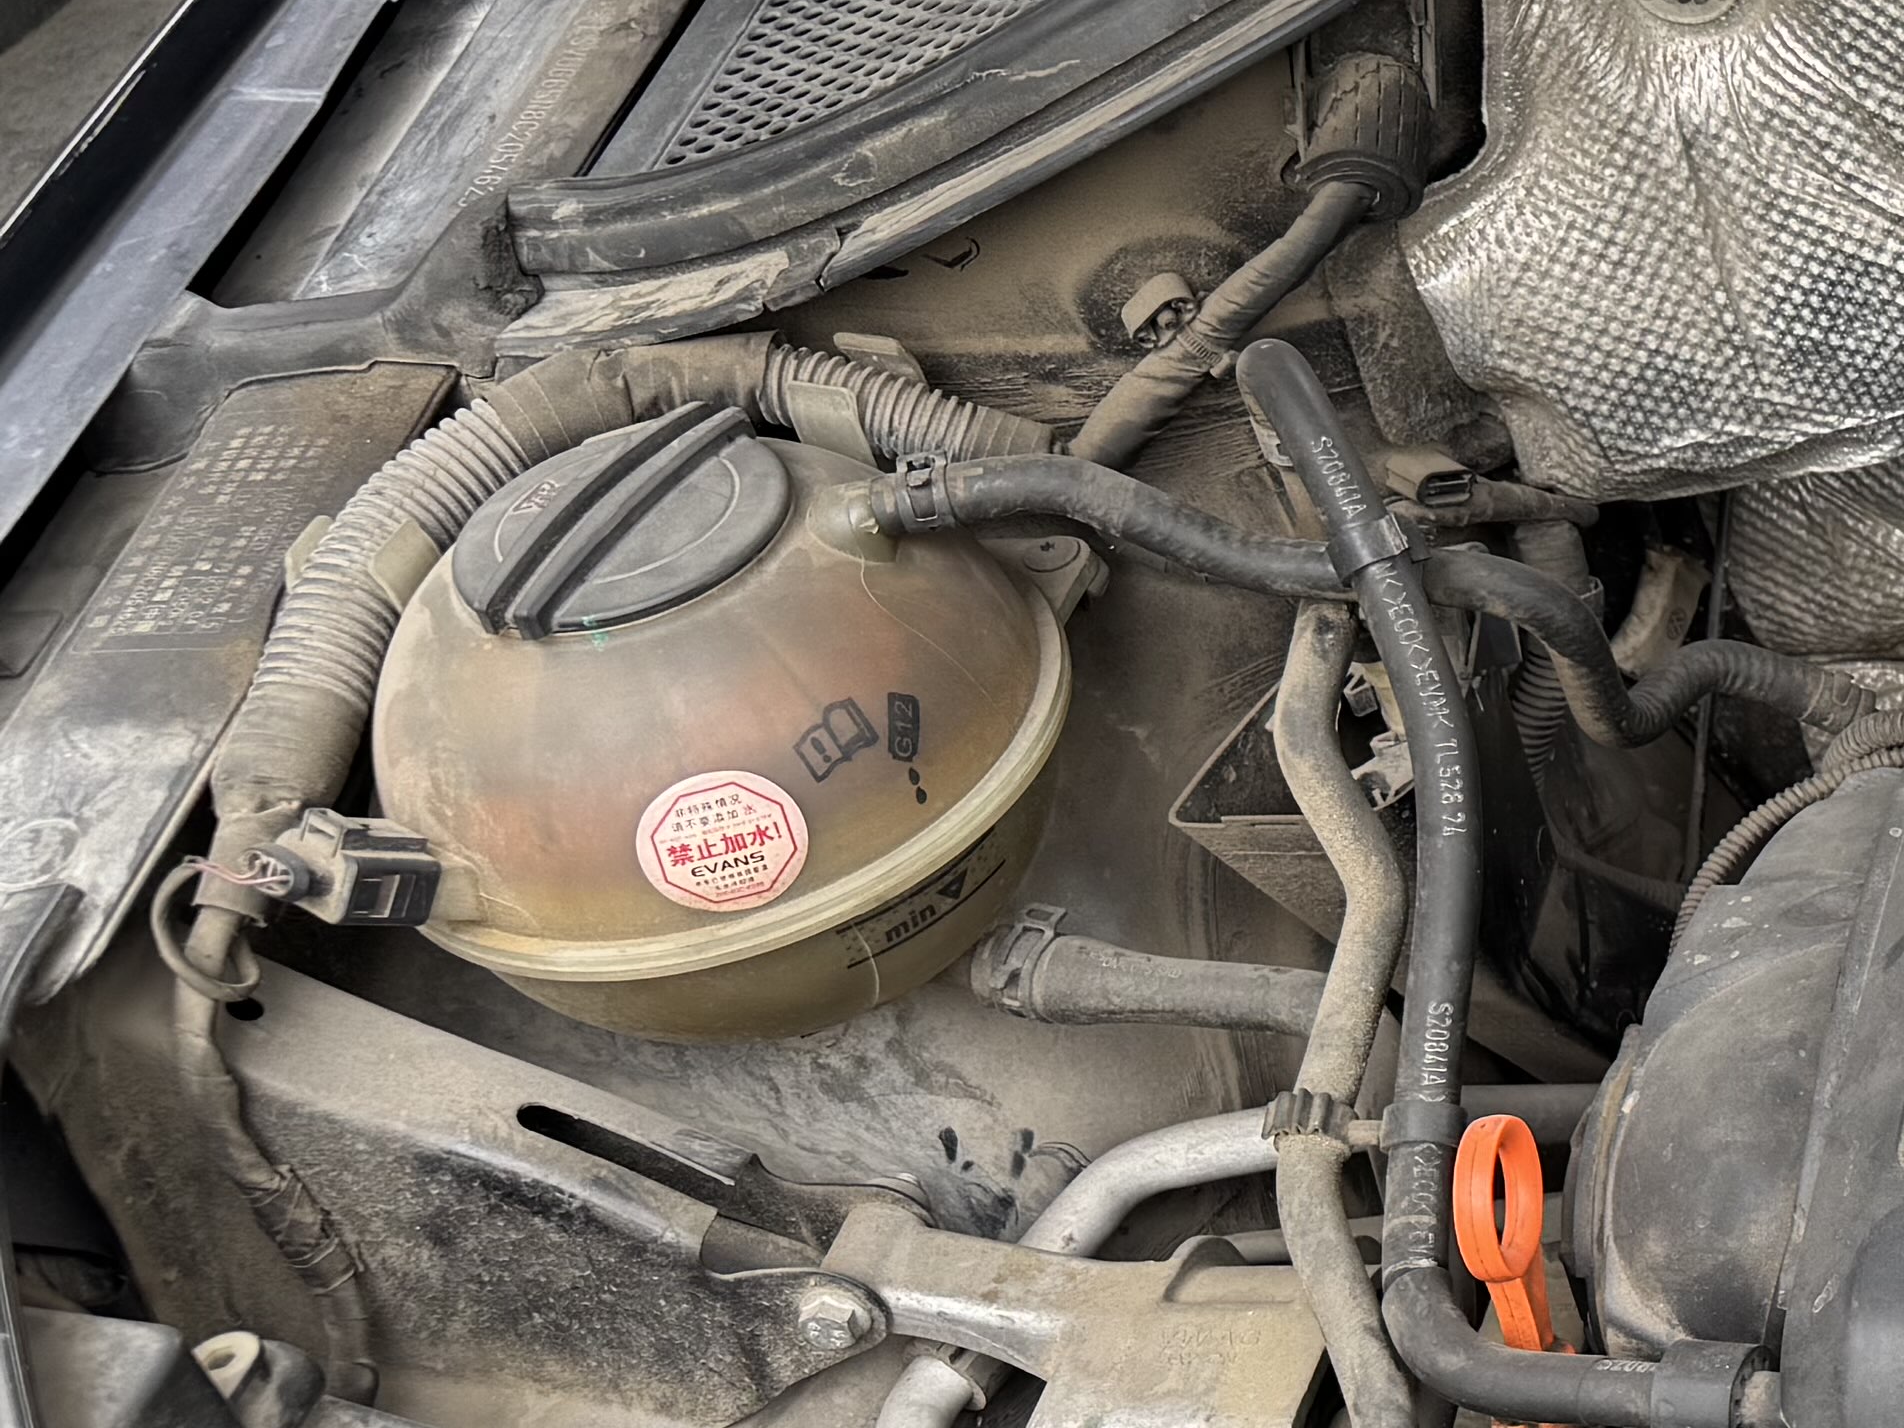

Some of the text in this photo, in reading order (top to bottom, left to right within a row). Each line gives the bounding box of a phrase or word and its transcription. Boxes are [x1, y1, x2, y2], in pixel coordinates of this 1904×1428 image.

[894, 700, 913, 758] G12
[666, 821, 783, 868] 禁止加水!
[691, 851, 766, 877] EVANS
[884, 903, 938, 943] min
